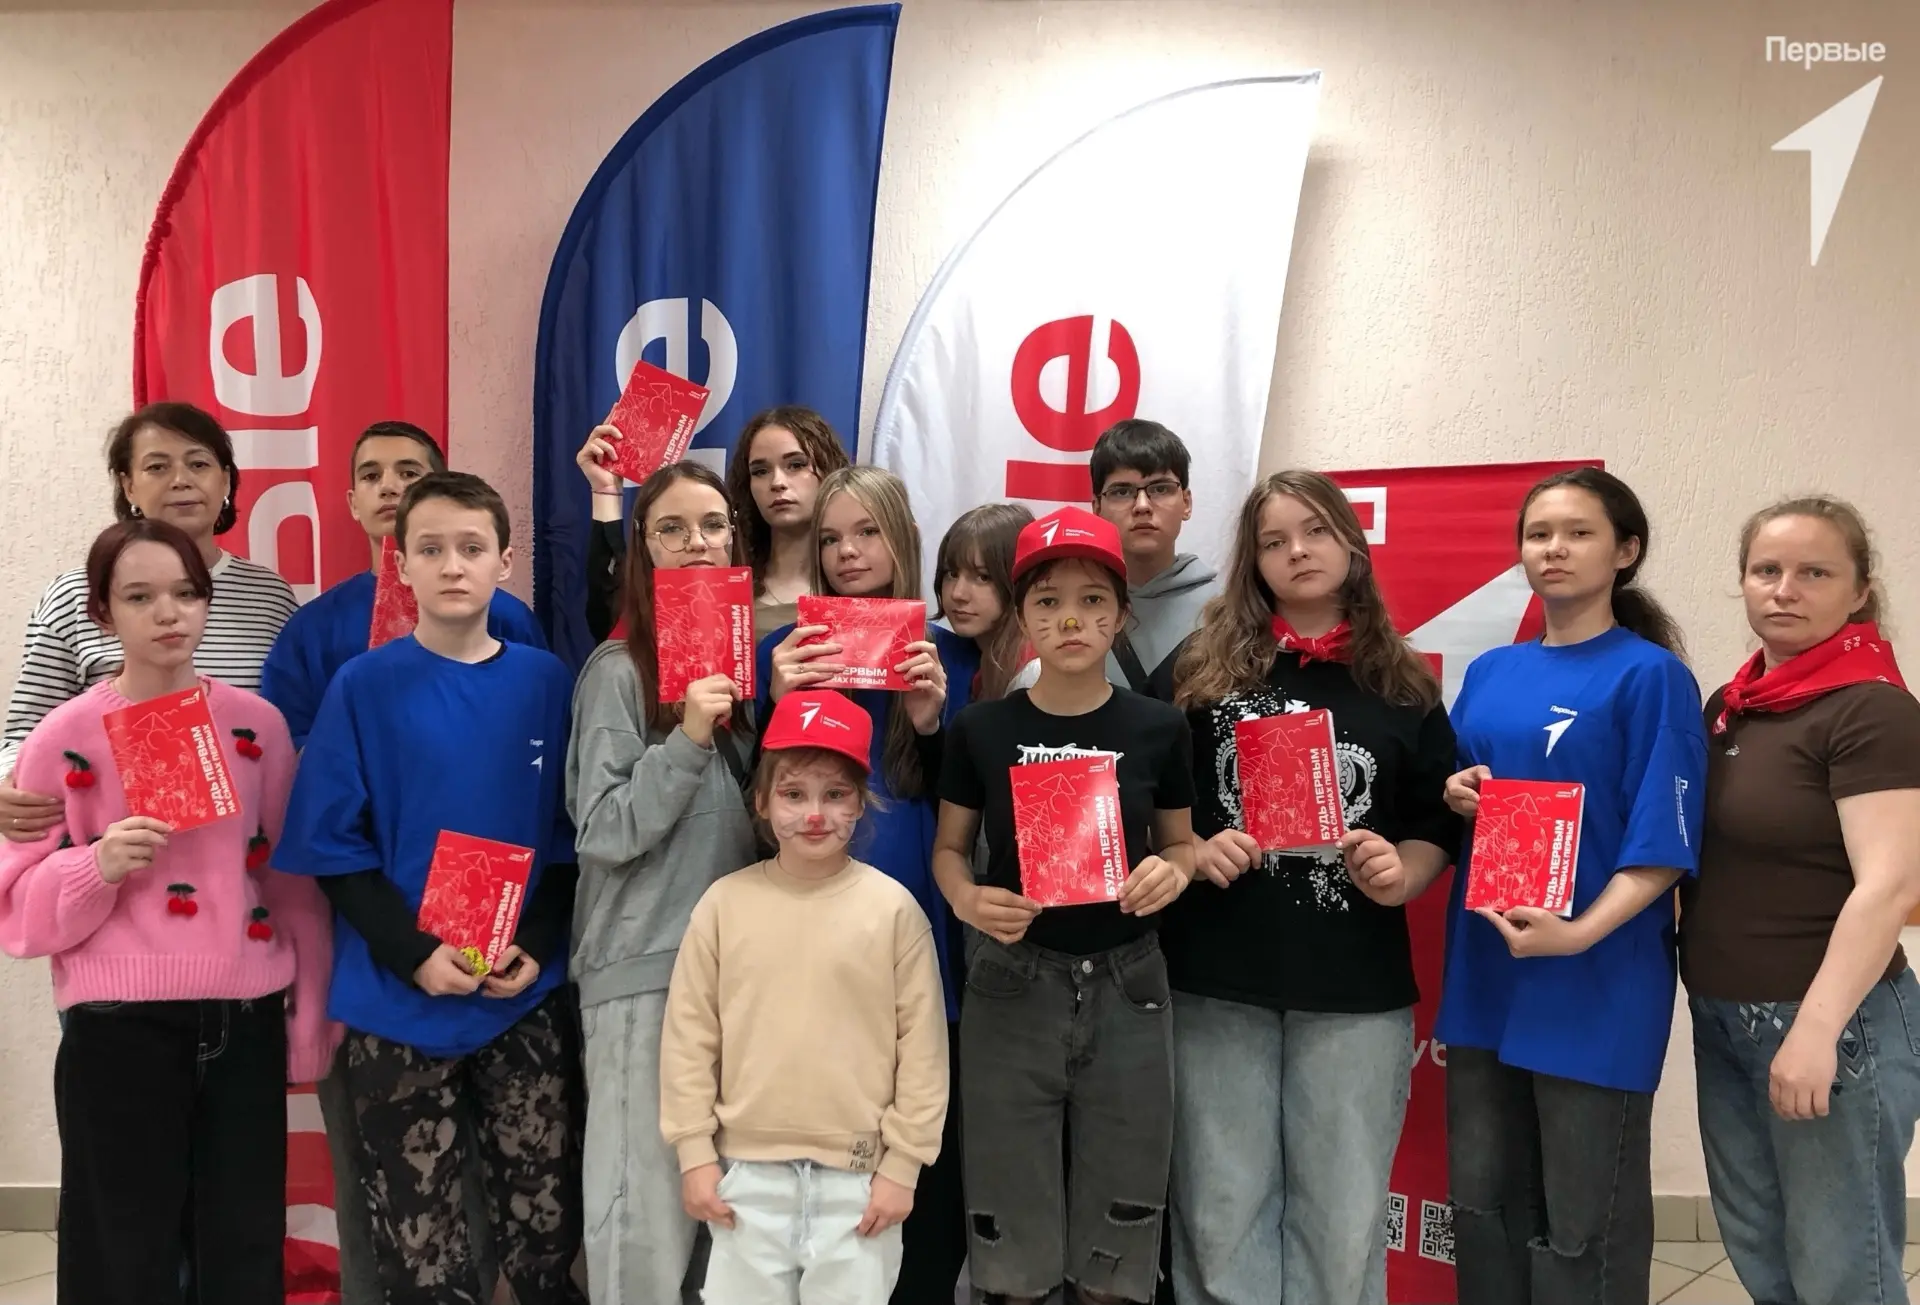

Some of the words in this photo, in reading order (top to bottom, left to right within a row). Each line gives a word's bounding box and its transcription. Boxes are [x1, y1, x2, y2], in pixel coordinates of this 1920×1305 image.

[663, 414, 689, 460] ПЕРВЫМ
[678, 418, 695, 451] ПЕРВЫХ
[731, 604, 743, 660] ПЕРВЫМ
[742, 605, 751, 642] ПЕРВЫХ
[744, 644, 752, 682] СМЕНАХ
[831, 676, 849, 684] НАХ
[843, 667, 887, 677] ЕРВЫМ
[745, 682, 752, 695] НА
[191, 725, 216, 782] ПЕРВЫМ
[202, 723, 221, 761] ПЕРВЫХ
[215, 761, 233, 801] СМЕНАХ
[1310, 748, 1325, 804] ПЕРВЫМ
[1321, 747, 1332, 786] ПЕРВЫХ
[210, 782, 227, 816] БУДЬ
[227, 802, 236, 813] НА
[1108, 796, 1118, 838] ПЕРВЫХ
[1326, 788, 1338, 827] СМЕНАХ
[1095, 796, 1111, 857] ПЕРВЫМ
[1318, 805, 1331, 840] БУДЬ
[1332, 827, 1340, 839] НА
[1564, 820, 1575, 858] ПЕРВЫХ
[1112, 838, 1123, 880] СМЕНАХ
[1550, 819, 1565, 875] ПЕРВЫМ
[1104, 859, 1116, 897] БУДЬ
[1543, 877, 1558, 909] БУДЬ
[1558, 858, 1569, 895] СМЕНАХ
[492, 881, 514, 935] ПЕРВЫМ
[1555, 896, 1563, 908] НА
